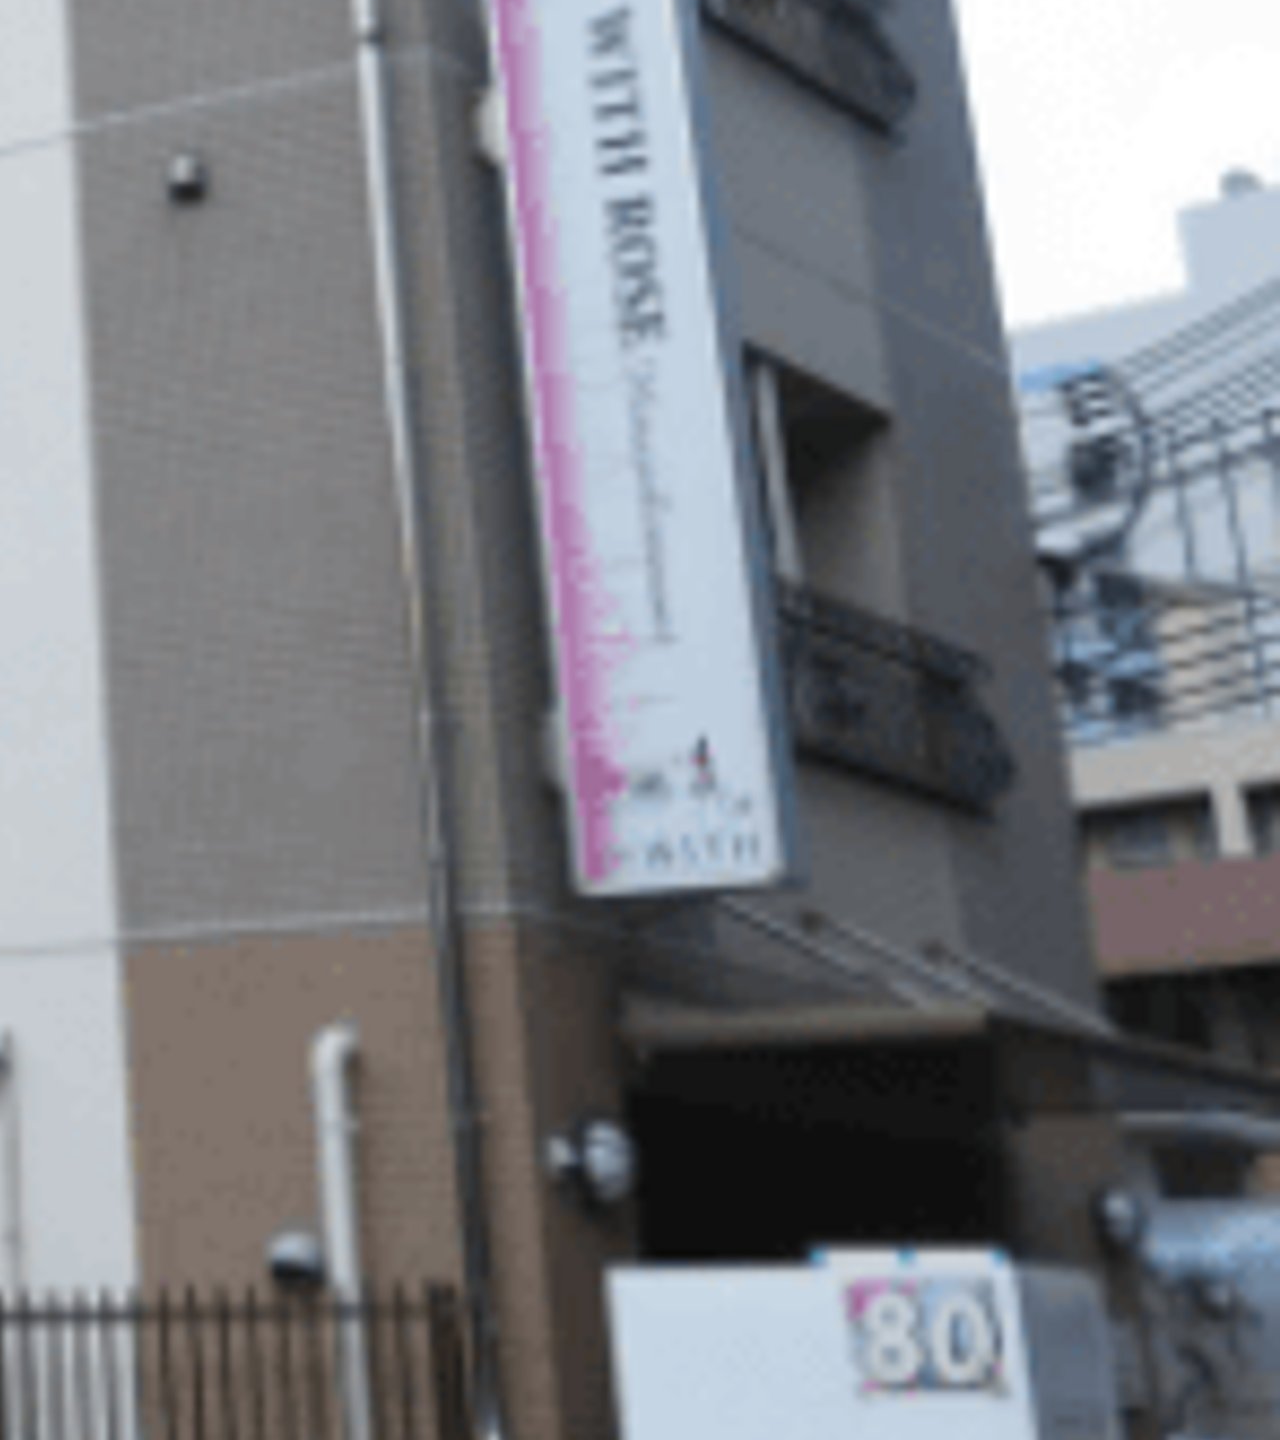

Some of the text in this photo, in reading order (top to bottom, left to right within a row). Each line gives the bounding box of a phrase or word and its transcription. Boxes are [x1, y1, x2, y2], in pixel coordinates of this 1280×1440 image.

[586, 1, 649, 178] WITH
[603, 194, 668, 348] ROSE
[858, 1289, 994, 1388] 80
